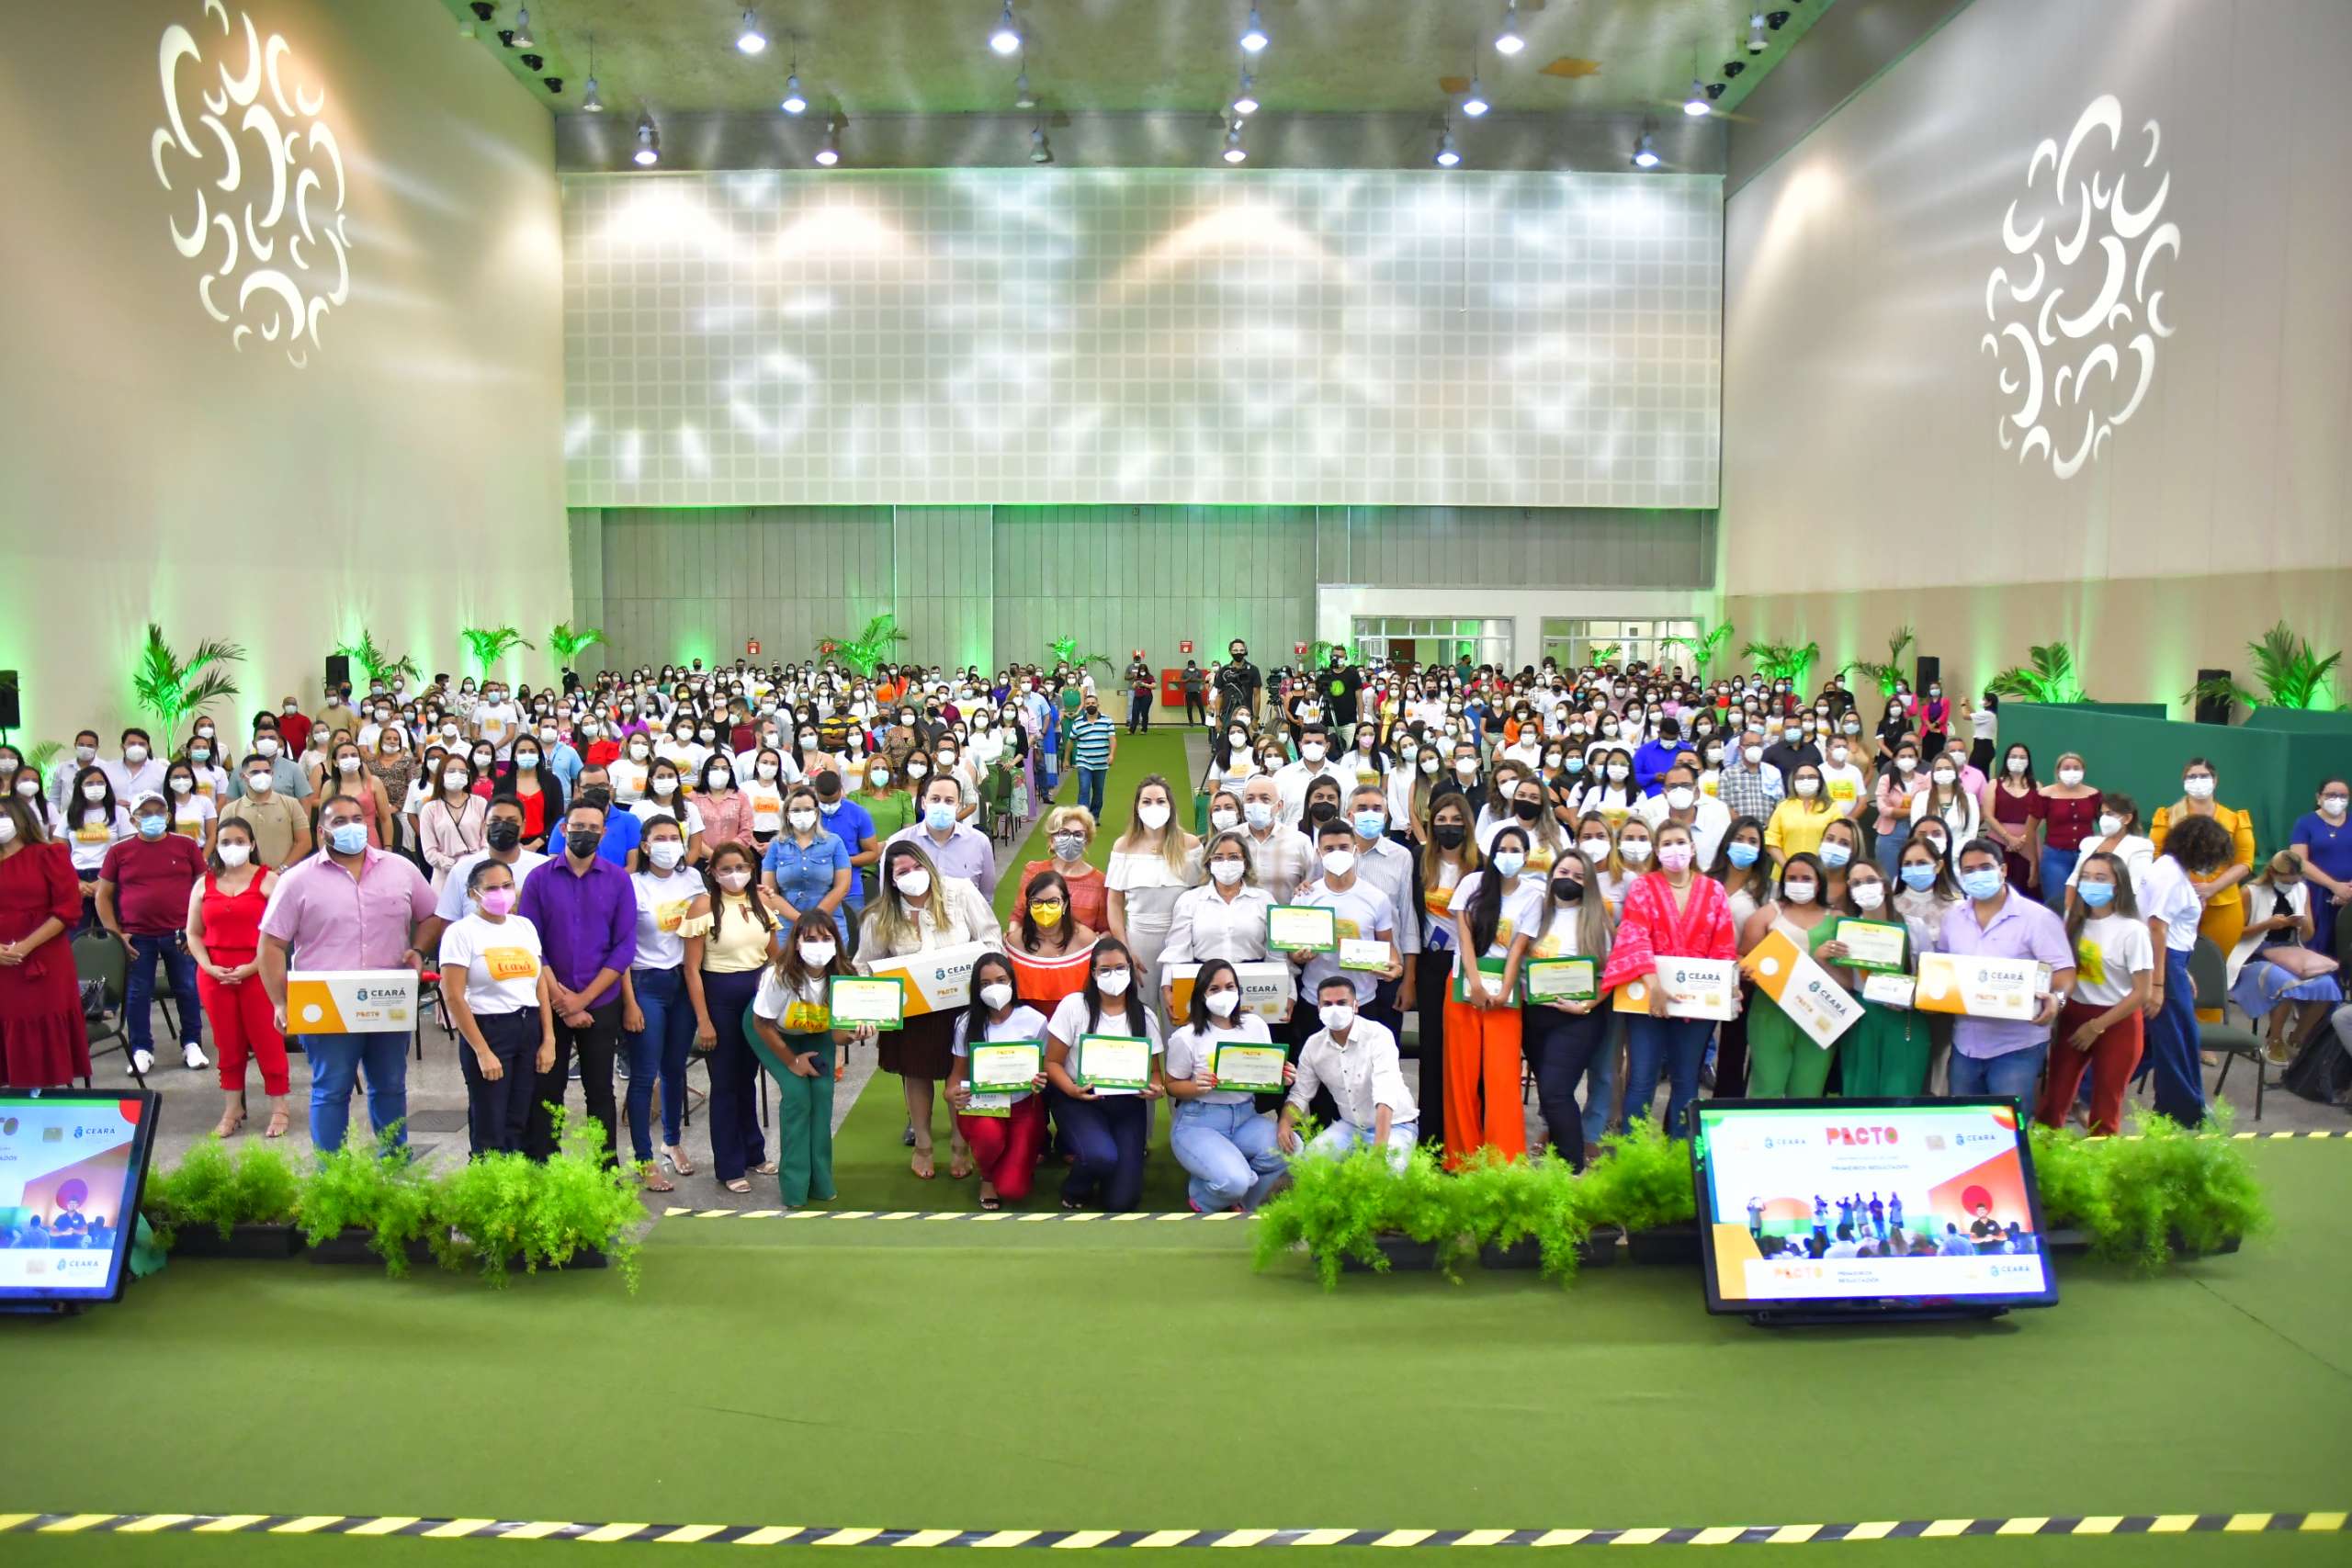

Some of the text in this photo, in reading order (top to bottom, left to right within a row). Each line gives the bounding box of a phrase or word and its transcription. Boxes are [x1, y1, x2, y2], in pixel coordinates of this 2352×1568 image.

[947, 964, 972, 975] CEAR
[370, 987, 406, 997] CEARÁ
[1246, 983, 1278, 993] CEARÁ
[1826, 1126, 1899, 1145] PACTO
